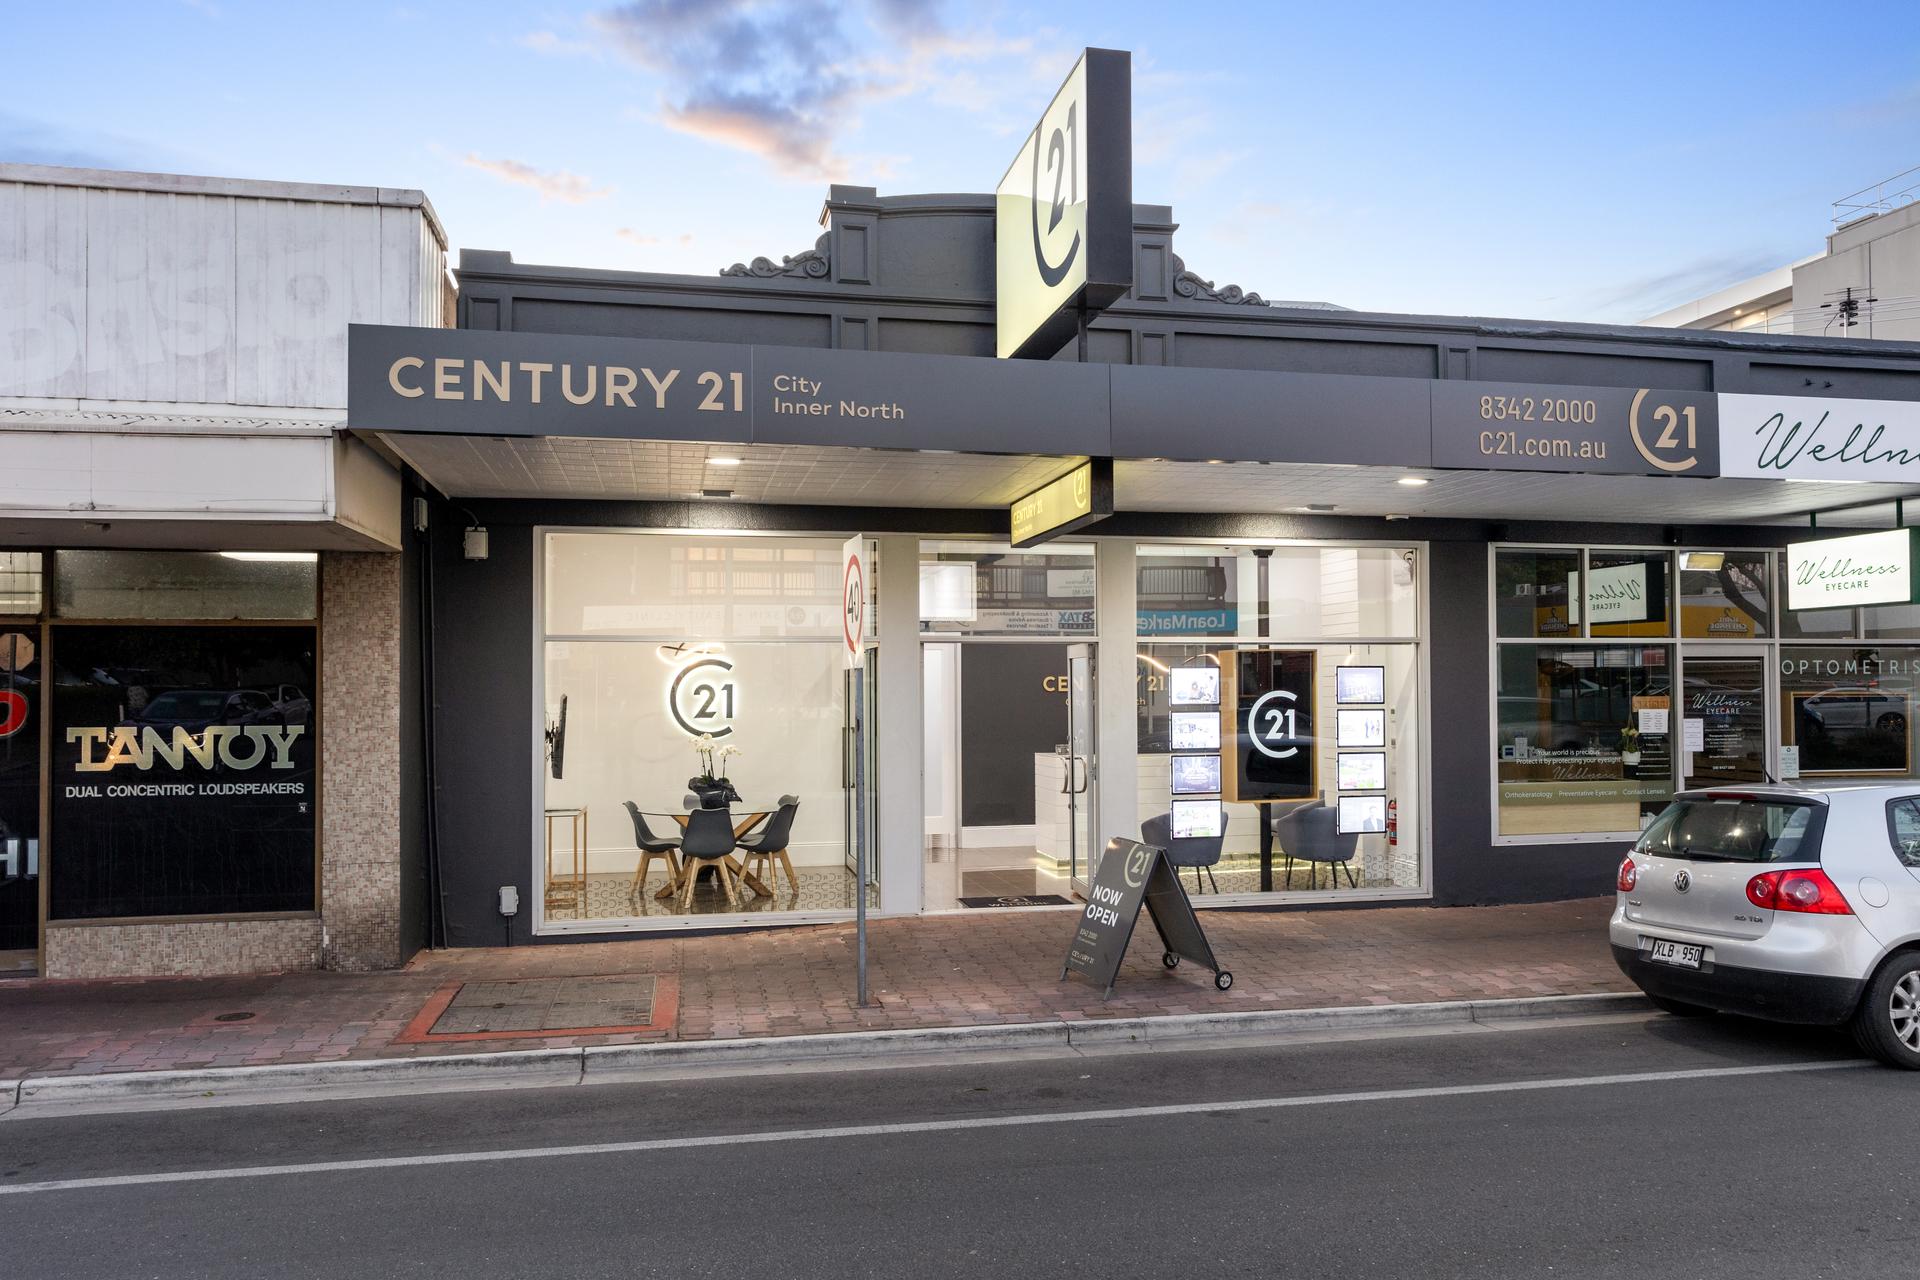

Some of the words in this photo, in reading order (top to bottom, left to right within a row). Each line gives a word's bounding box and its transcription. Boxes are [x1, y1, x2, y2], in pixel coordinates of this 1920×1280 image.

[388, 356, 680, 408] CENTURY
[697, 372, 743, 411] 21
[773, 376, 821, 398] City
[774, 397, 831, 416] Inner
[839, 400, 904, 420] North
[1479, 396, 1535, 422] 8342
[1542, 399, 1596, 424] 2000
[1478, 431, 1606, 459] C21.com.au
[1756, 411, 1920, 470] Welln
[1796, 555, 1901, 587] Wellness
[1825, 580, 1869, 591] EYECARE
[847, 581, 859, 623] 40
[1692, 693, 1752, 709] Wellness
[66, 725, 305, 771] TANNOY
[1575, 749, 1601, 757] precious
[1552, 757, 1582, 766] protecting
[1583, 757, 1596, 765] your
[1597, 757, 1622, 765] eyesight
[66, 787, 102, 798] DUAL
[107, 785, 194, 797] CONCENTRIC
[199, 783, 304, 795] LOUDSPEAKERS
[1505, 791, 1553, 799] Orthokeratology
[1623, 788, 1645, 796] Contact
[1092, 885, 1123, 906] NOW
[1086, 905, 1119, 927] OPEN
[1654, 942, 1675, 958] XLB
[1682, 946, 1700, 962] 950
